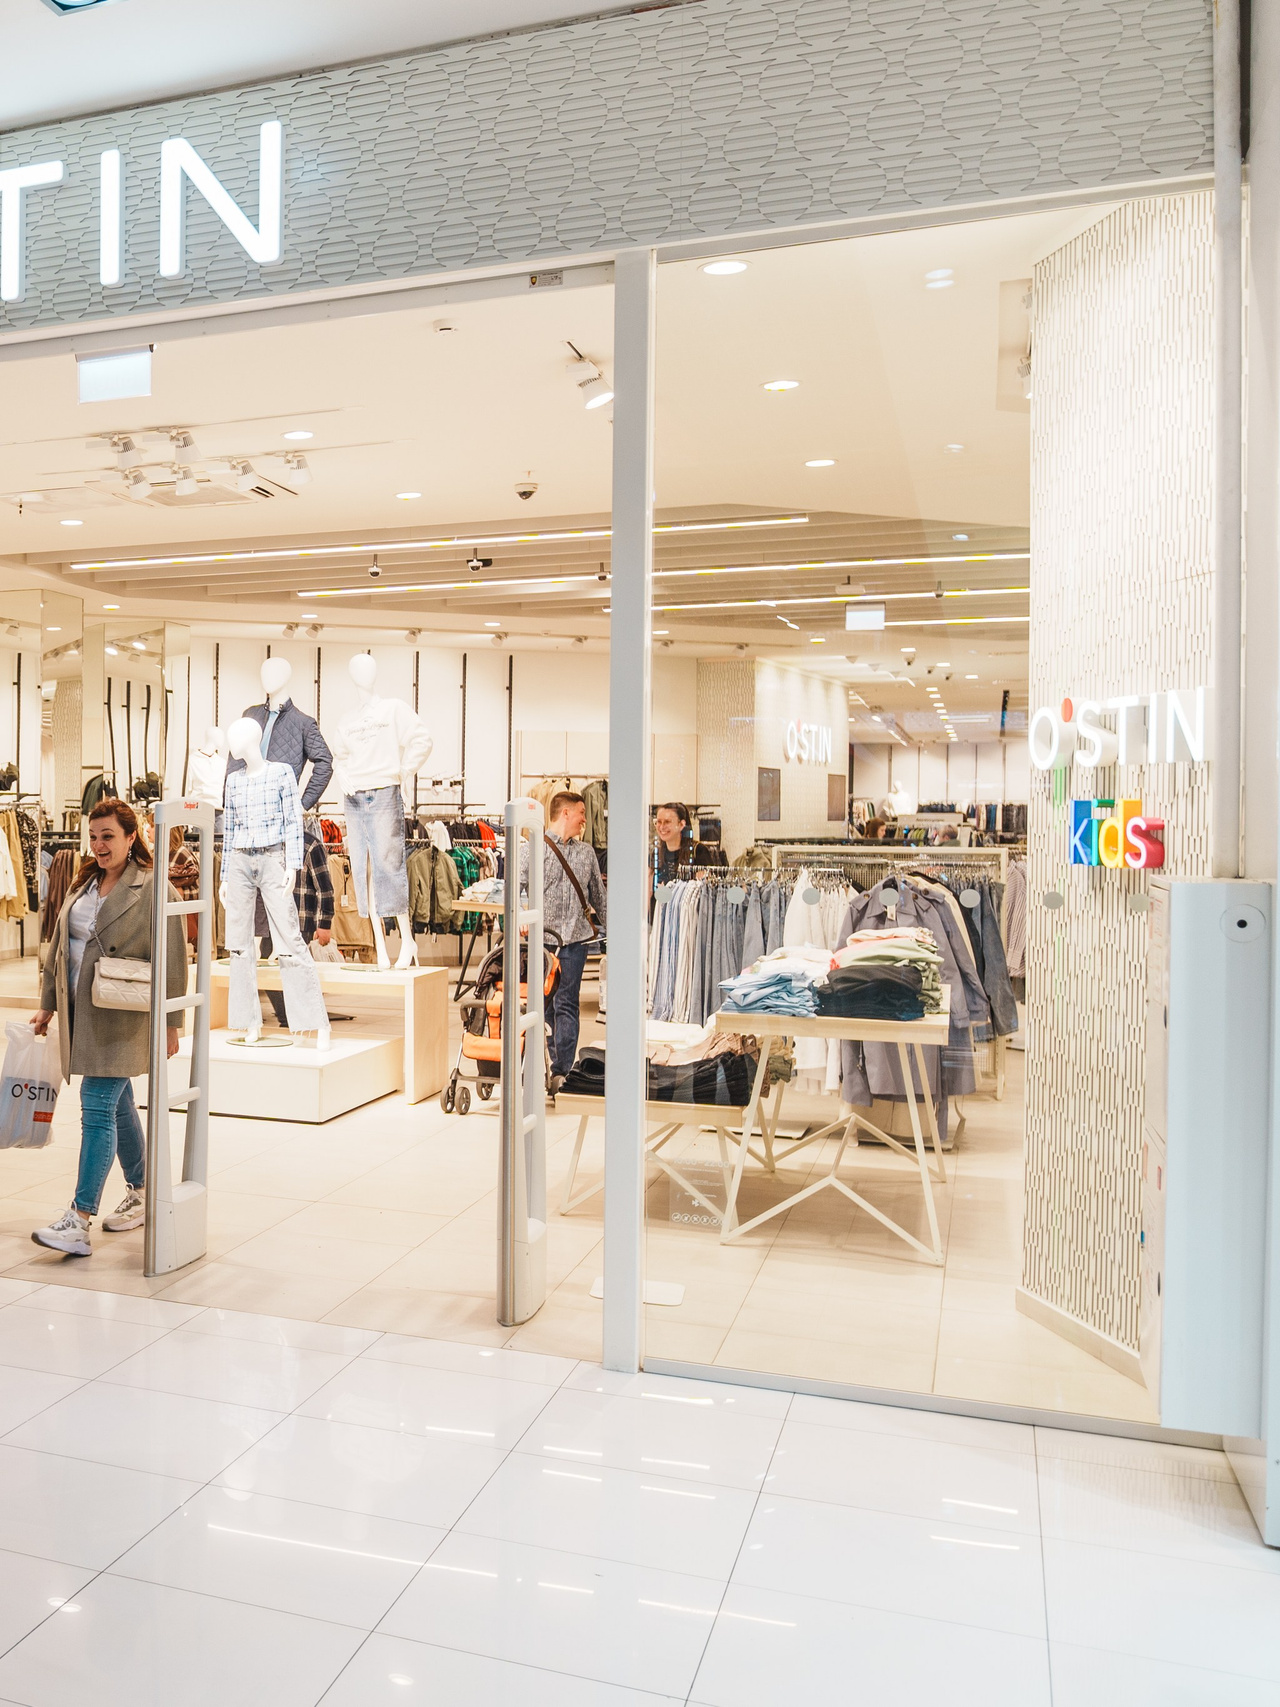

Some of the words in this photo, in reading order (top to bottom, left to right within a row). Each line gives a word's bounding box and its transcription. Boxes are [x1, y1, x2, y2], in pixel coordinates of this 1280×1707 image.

[786, 718, 832, 764] O'STIN
[1028, 685, 1207, 771] O'STIN
[1069, 799, 1158, 869] kids
